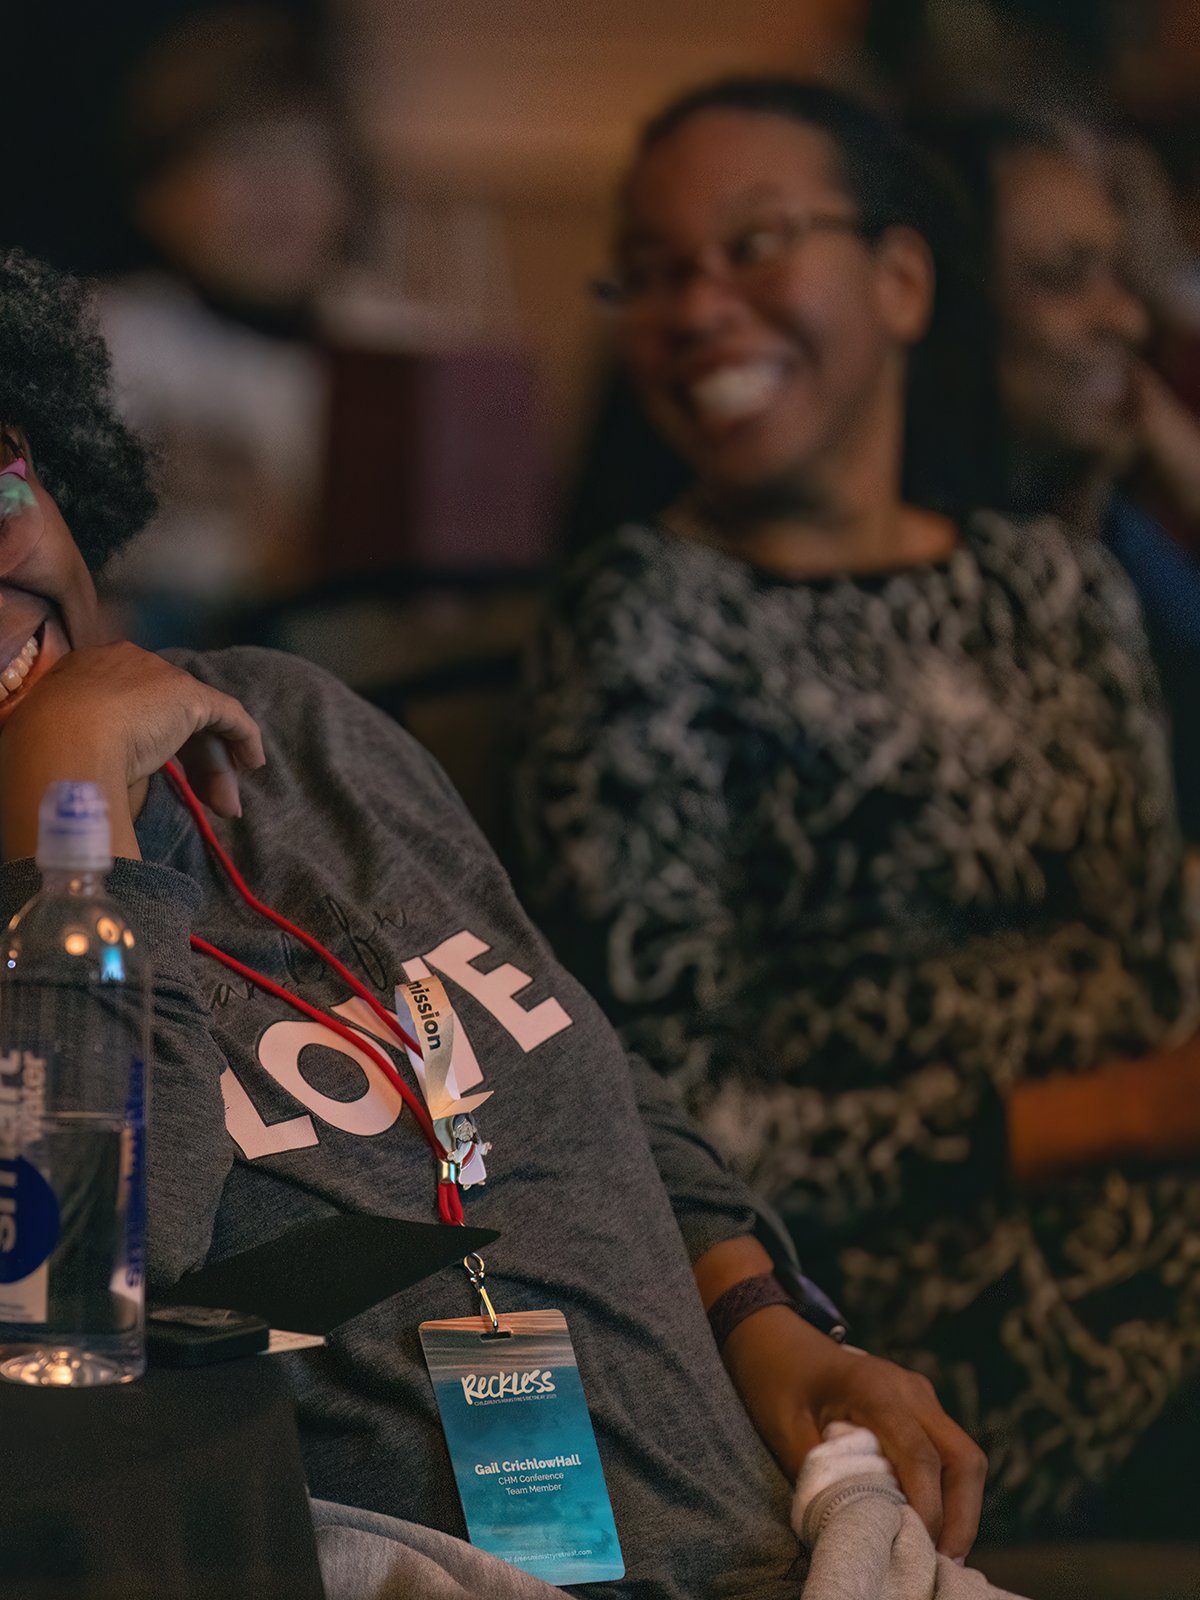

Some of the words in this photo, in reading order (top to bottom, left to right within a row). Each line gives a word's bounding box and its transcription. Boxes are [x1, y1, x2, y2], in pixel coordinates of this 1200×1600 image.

[220, 929, 574, 1161] LOVE
[475, 1462, 501, 1475] Gail
[502, 1454, 582, 1473] CrichlowHall
[498, 1475, 518, 1485] CHM
[519, 1472, 564, 1483] Conference
[505, 1486, 528, 1495] Team
[528, 1483, 562, 1494] Member
